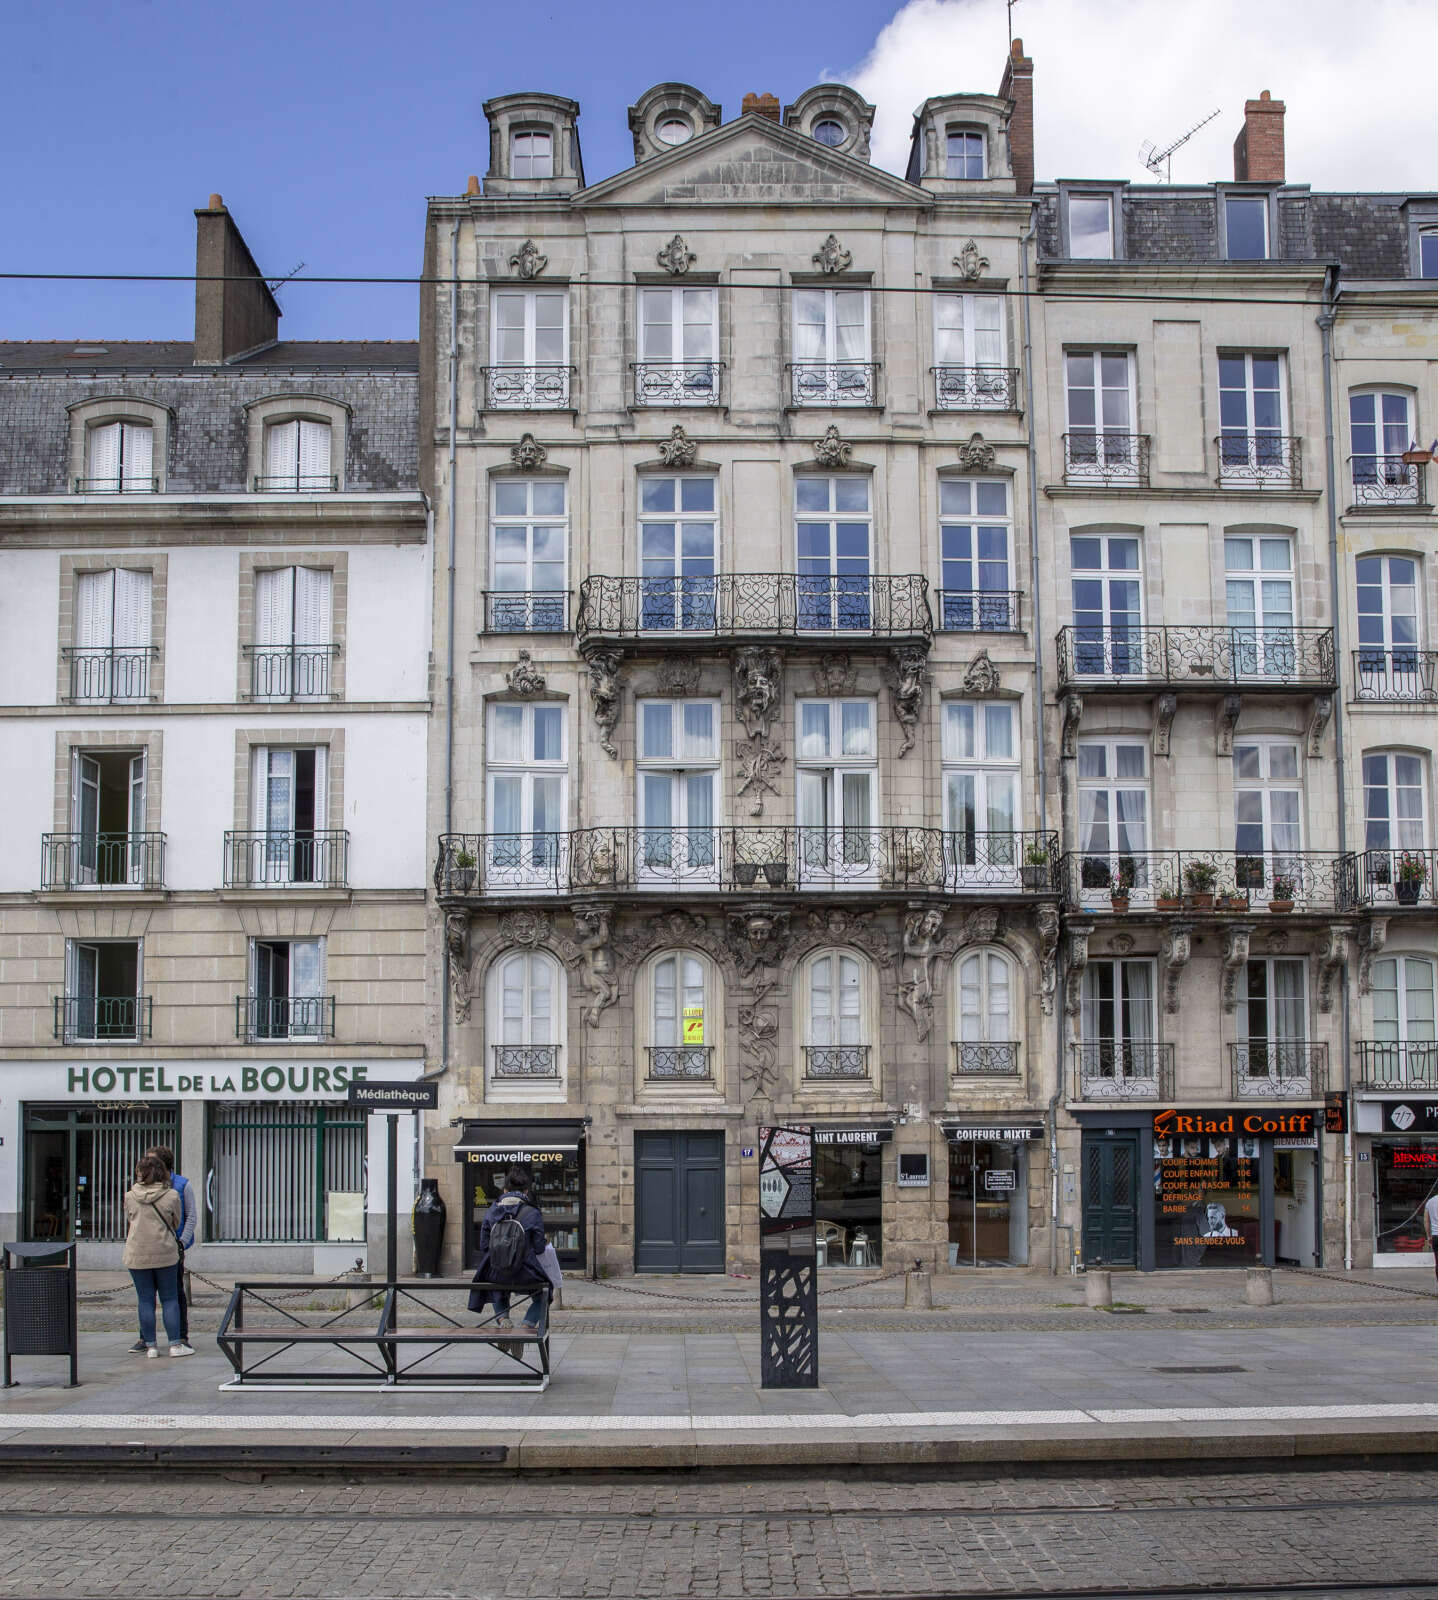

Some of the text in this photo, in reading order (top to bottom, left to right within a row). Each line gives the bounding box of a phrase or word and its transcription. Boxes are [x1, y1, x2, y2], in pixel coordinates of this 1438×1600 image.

[67, 1066, 173, 1093] HOTEL
[178, 1075, 203, 1092] DE
[210, 1075, 236, 1092] LA
[356, 1088, 430, 1102] Médiathèque
[1175, 1115, 1312, 1133] Riad Coiff
[814, 1131, 878, 1143] AINT LAURENT
[956, 1129, 1031, 1140] COIFFURE MIXTE
[1162, 1158, 1188, 1167] COUPE
[1189, 1158, 1219, 1167] HOMME
[1163, 1170, 1189, 1178] COUPE
[1190, 1169, 1219, 1178] ENFANT
[1163, 1182, 1189, 1190] COUPE
[1190, 1182, 1201, 1190] AU
[1202, 1181, 1230, 1189] RASOIR
[1163, 1205, 1188, 1213] BARBE
[1174, 1237, 1193, 1246] SANS
